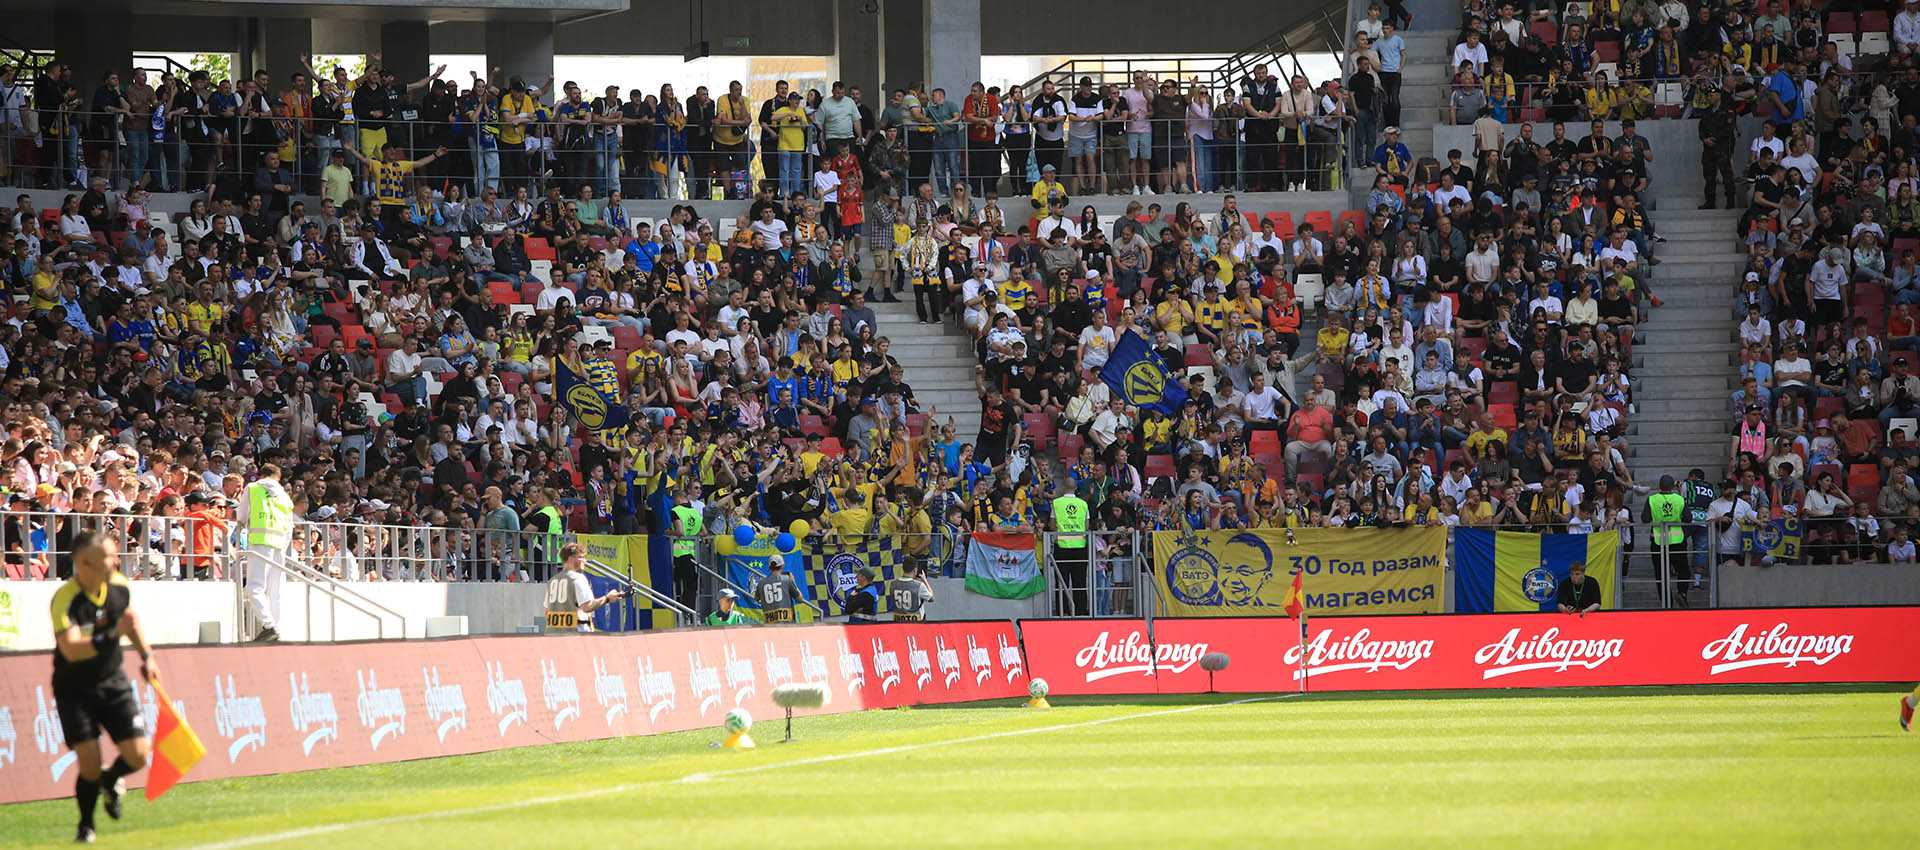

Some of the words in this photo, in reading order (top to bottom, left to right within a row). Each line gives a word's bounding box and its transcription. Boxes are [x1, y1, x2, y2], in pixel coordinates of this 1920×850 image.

[1695, 486, 1713, 498] 120
[1182, 571, 1209, 580] БАТЭ
[1288, 555, 1321, 576] 30
[1329, 559, 1365, 576] Год
[1373, 554, 1440, 576] разам,
[549, 578, 568, 604] 90
[763, 582, 783, 604] 65
[894, 589, 912, 610] 59
[1305, 584, 1435, 608] магаемся
[765, 609, 788, 622] PHOTO
[1283, 628, 1435, 680] Аліварыя
[1474, 627, 1624, 680] Аліварыя
[1701, 622, 1855, 675] Аліварыя
